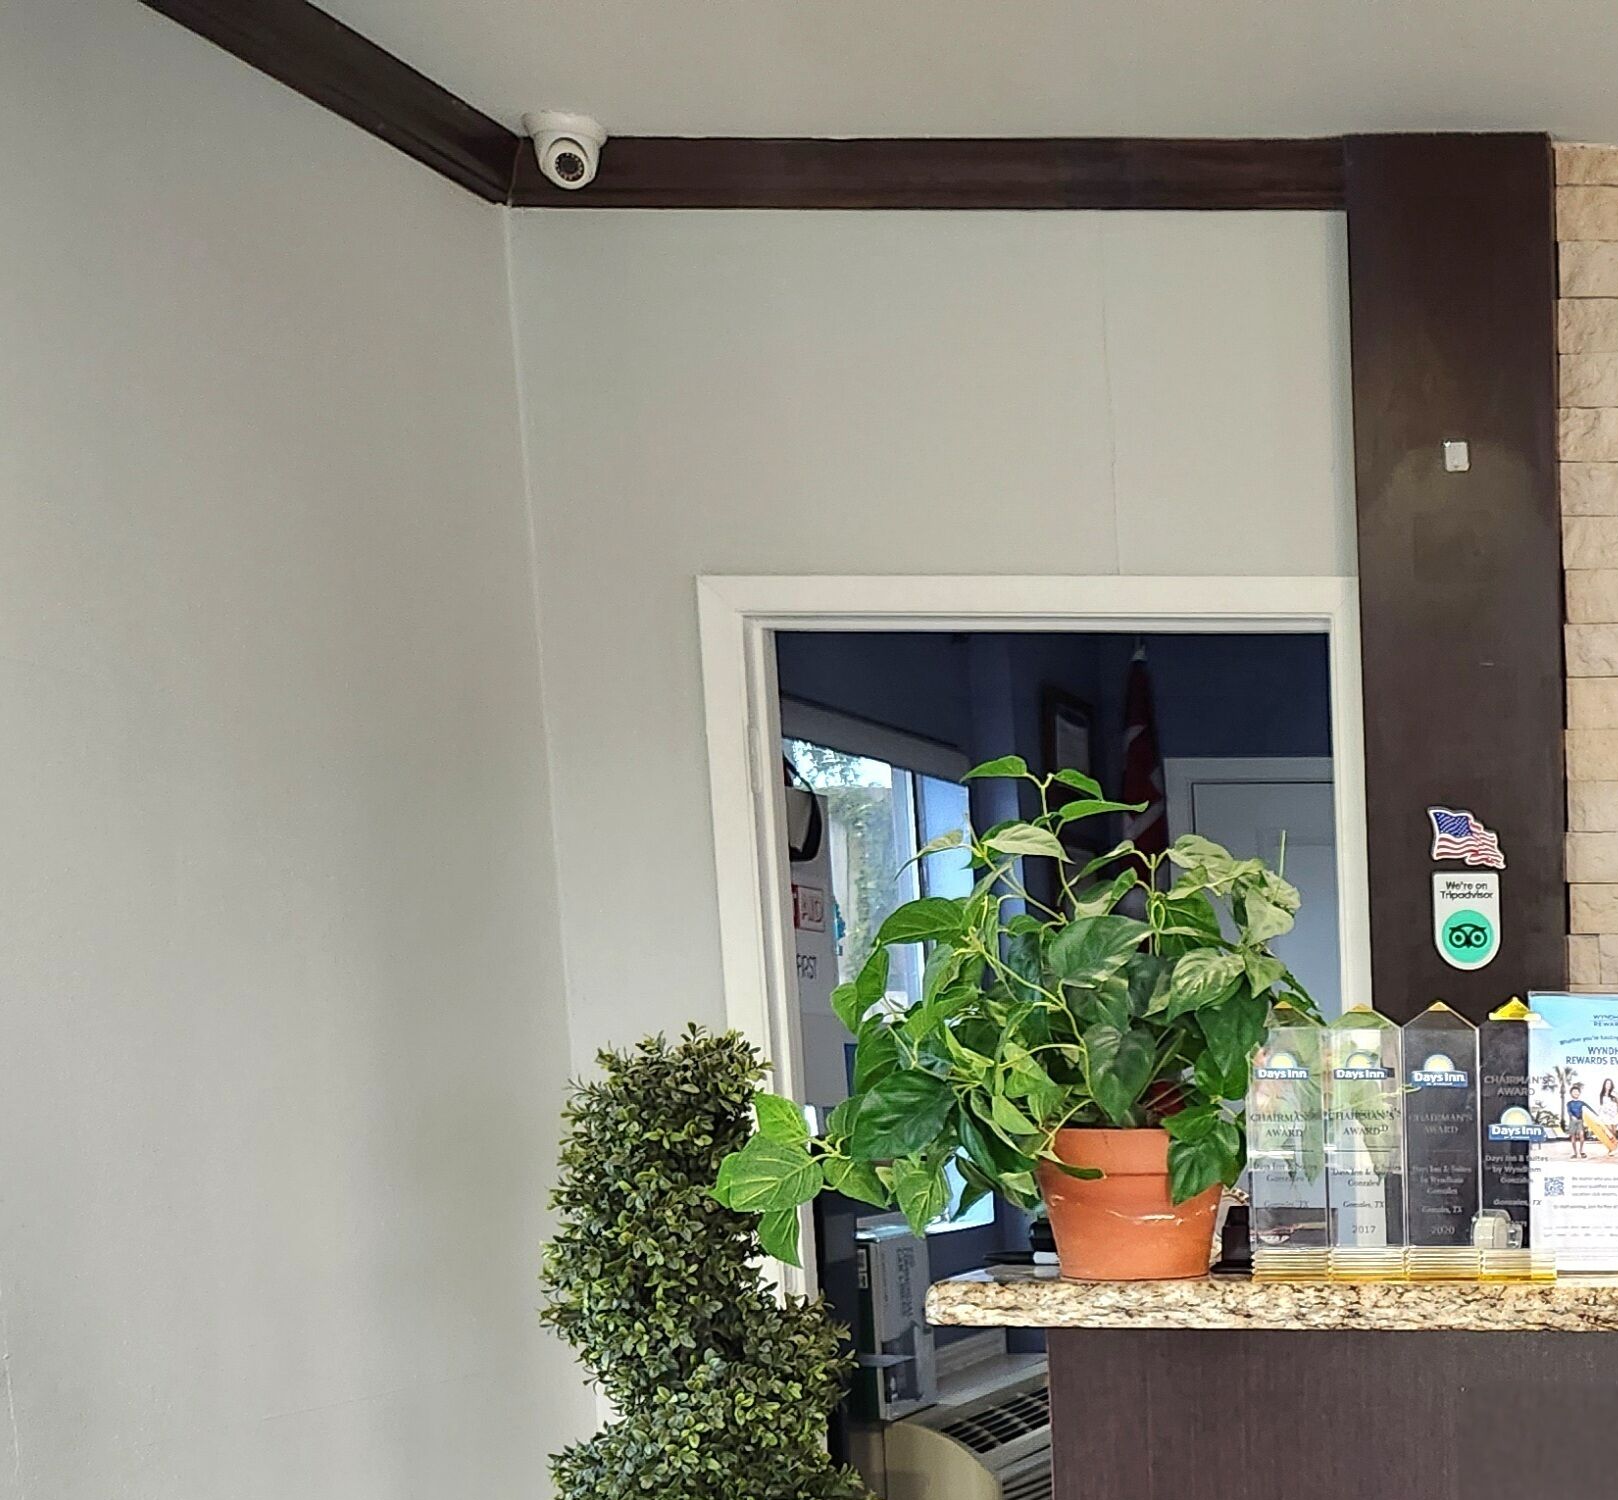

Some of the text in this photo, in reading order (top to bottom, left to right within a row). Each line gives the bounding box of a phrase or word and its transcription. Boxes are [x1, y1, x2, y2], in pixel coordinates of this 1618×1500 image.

[1446, 881, 1473, 890] We're
[1440, 891, 1493, 901] Tripadvisor
[1566, 1056, 1608, 1065] REWARDS
[1258, 1069, 1308, 1079] Days Inn
[1335, 1069, 1386, 1079] Days Inn
[1414, 1073, 1465, 1083] Days Inn
[1497, 1087, 1535, 1096] AWARD
[1266, 1128, 1303, 1137] AWARD
[1424, 1125, 1459, 1134] AWARD
[1491, 1126, 1542, 1136] Days Inn
[1352, 1225, 1377, 1234] 2017
[1431, 1225, 1456, 1234] 2020
